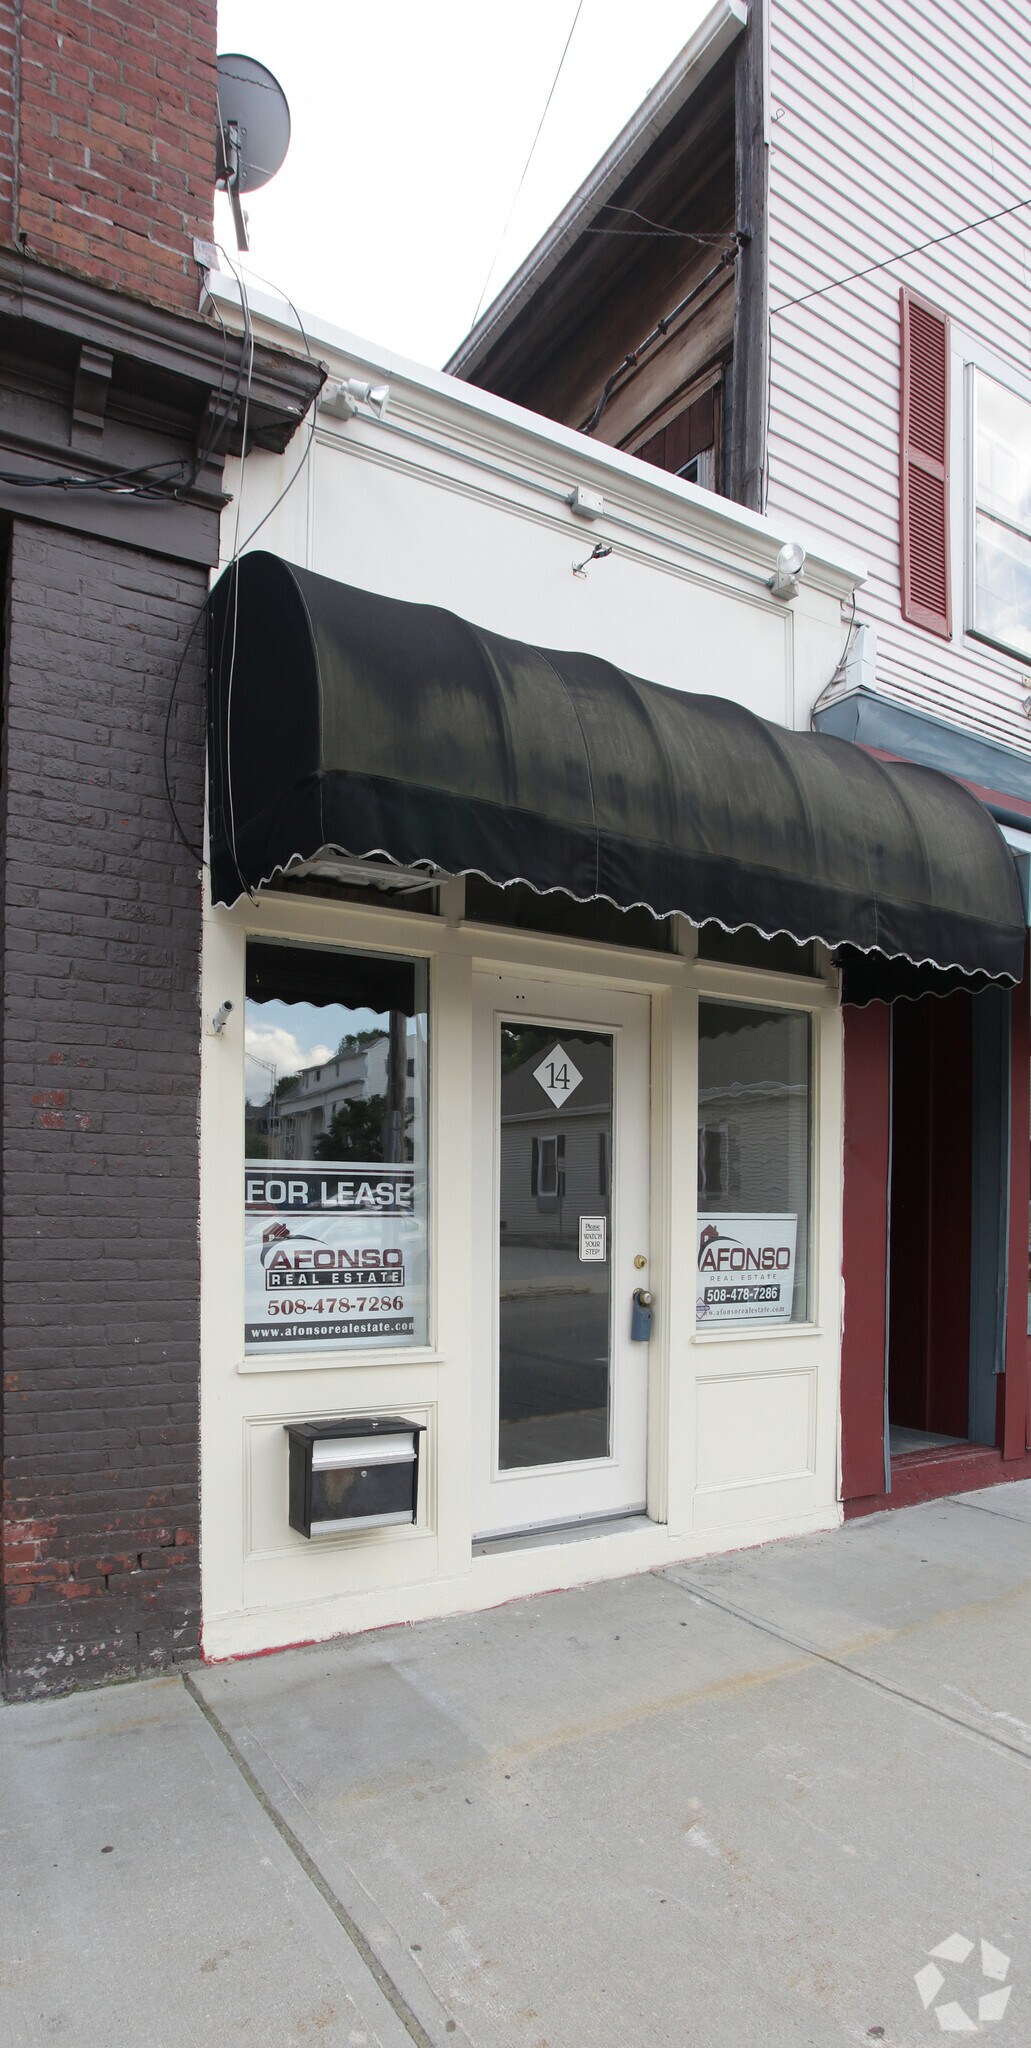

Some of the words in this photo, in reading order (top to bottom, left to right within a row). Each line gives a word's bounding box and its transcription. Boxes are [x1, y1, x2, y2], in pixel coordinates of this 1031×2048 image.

[545, 1062, 570, 1090] 14
[246, 1180, 309, 1204] FOR
[320, 1181, 411, 1205] LEASE
[583, 1233, 602, 1241] WATCH
[268, 1248, 403, 1269] AFONSO
[701, 1247, 791, 1271] AFONSO
[271, 1273, 320, 1285] REAL
[332, 1271, 399, 1284] ESTATE
[741, 1273, 777, 1281] ESTATE
[706, 1286, 778, 1302] 508-478-7286
[267, 1296, 404, 1316] 508-478-7286
